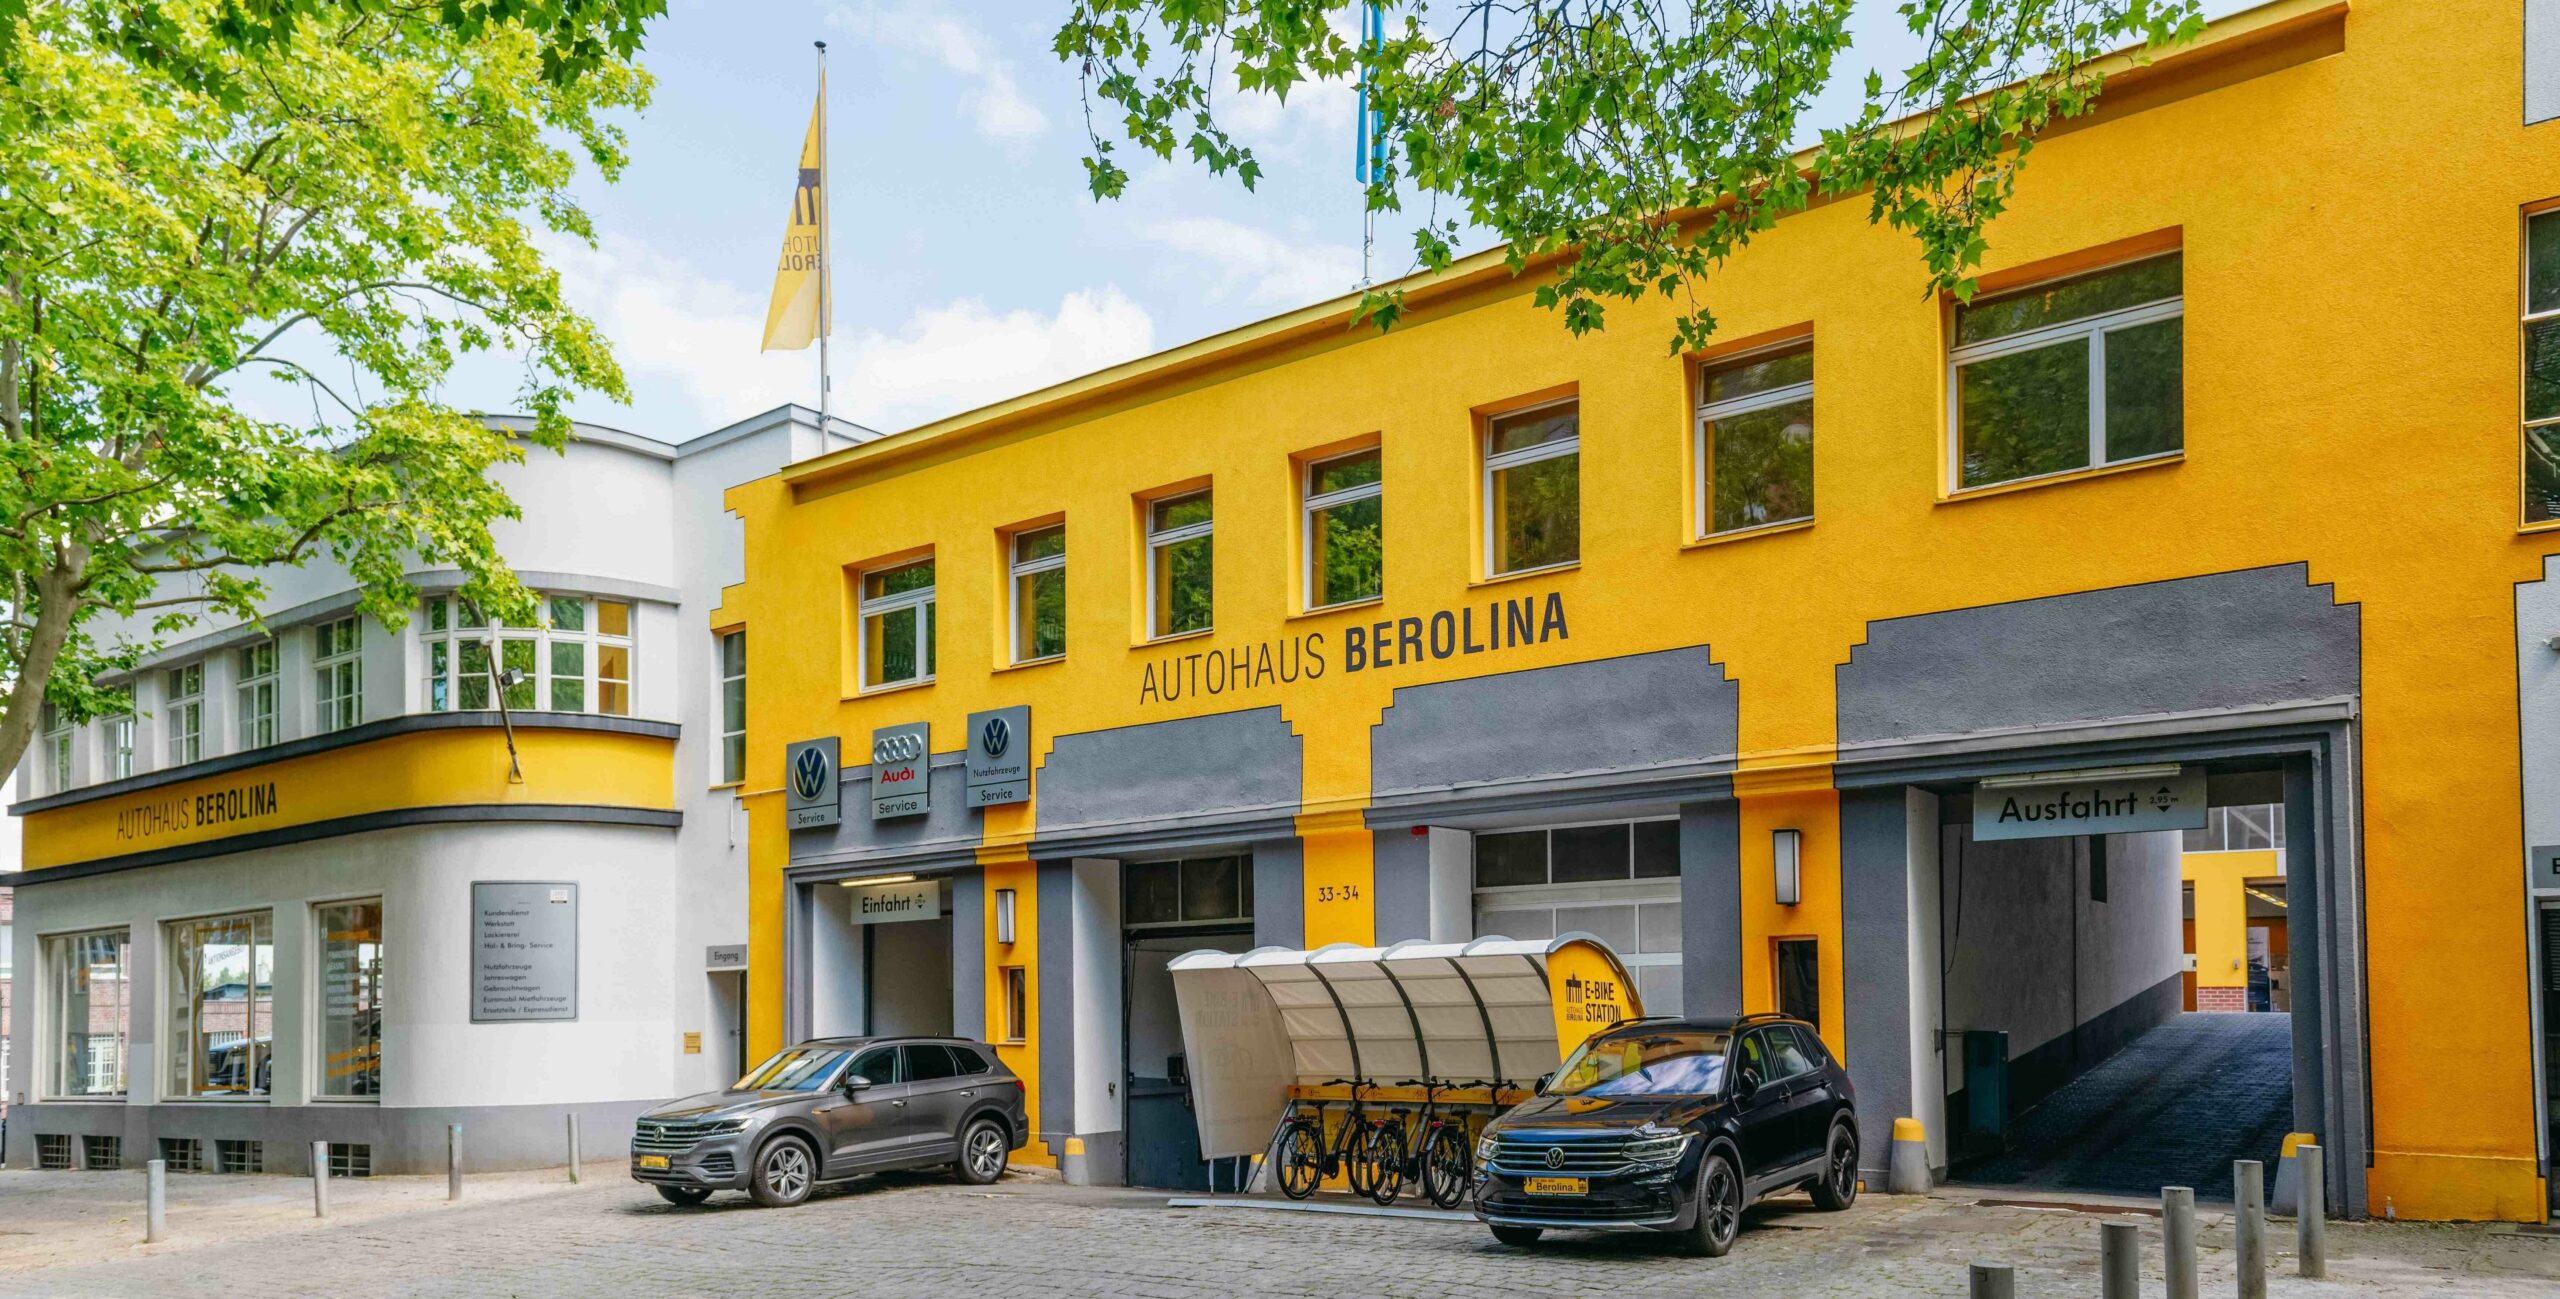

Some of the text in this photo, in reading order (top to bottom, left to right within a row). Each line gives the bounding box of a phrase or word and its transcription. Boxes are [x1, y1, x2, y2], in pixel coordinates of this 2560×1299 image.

[1139, 591, 1569, 705] AUTOHAUS BEROLINA
[880, 766, 915, 784] Audi
[973, 764, 1021, 779] Nutzfahrzeuge
[981, 790, 1013, 802] Service
[117, 782, 278, 841] AUTOHAUS BEROLINA
[879, 800, 918, 814] Service
[1998, 789, 2138, 824] Ausfahrt
[797, 812, 825, 825] Service
[1318, 885, 1359, 903] 33-34
[862, 893, 911, 914] Einfahrt
[484, 909, 530, 917] Kundendienst
[714, 951, 739, 962] Eingang
[483, 963, 533, 971] Nutzfahrzeuge
[483, 974, 527, 982] Jahreswagen
[1585, 980, 1615, 1001] E-BIKE
[483, 995, 567, 1004] Euromobil Mietfahrzeuge
[483, 1006, 517, 1014] Ersatzteile
[523, 1006, 568, 1015] Expressdienst
[1585, 1003, 1621, 1023] STATION
